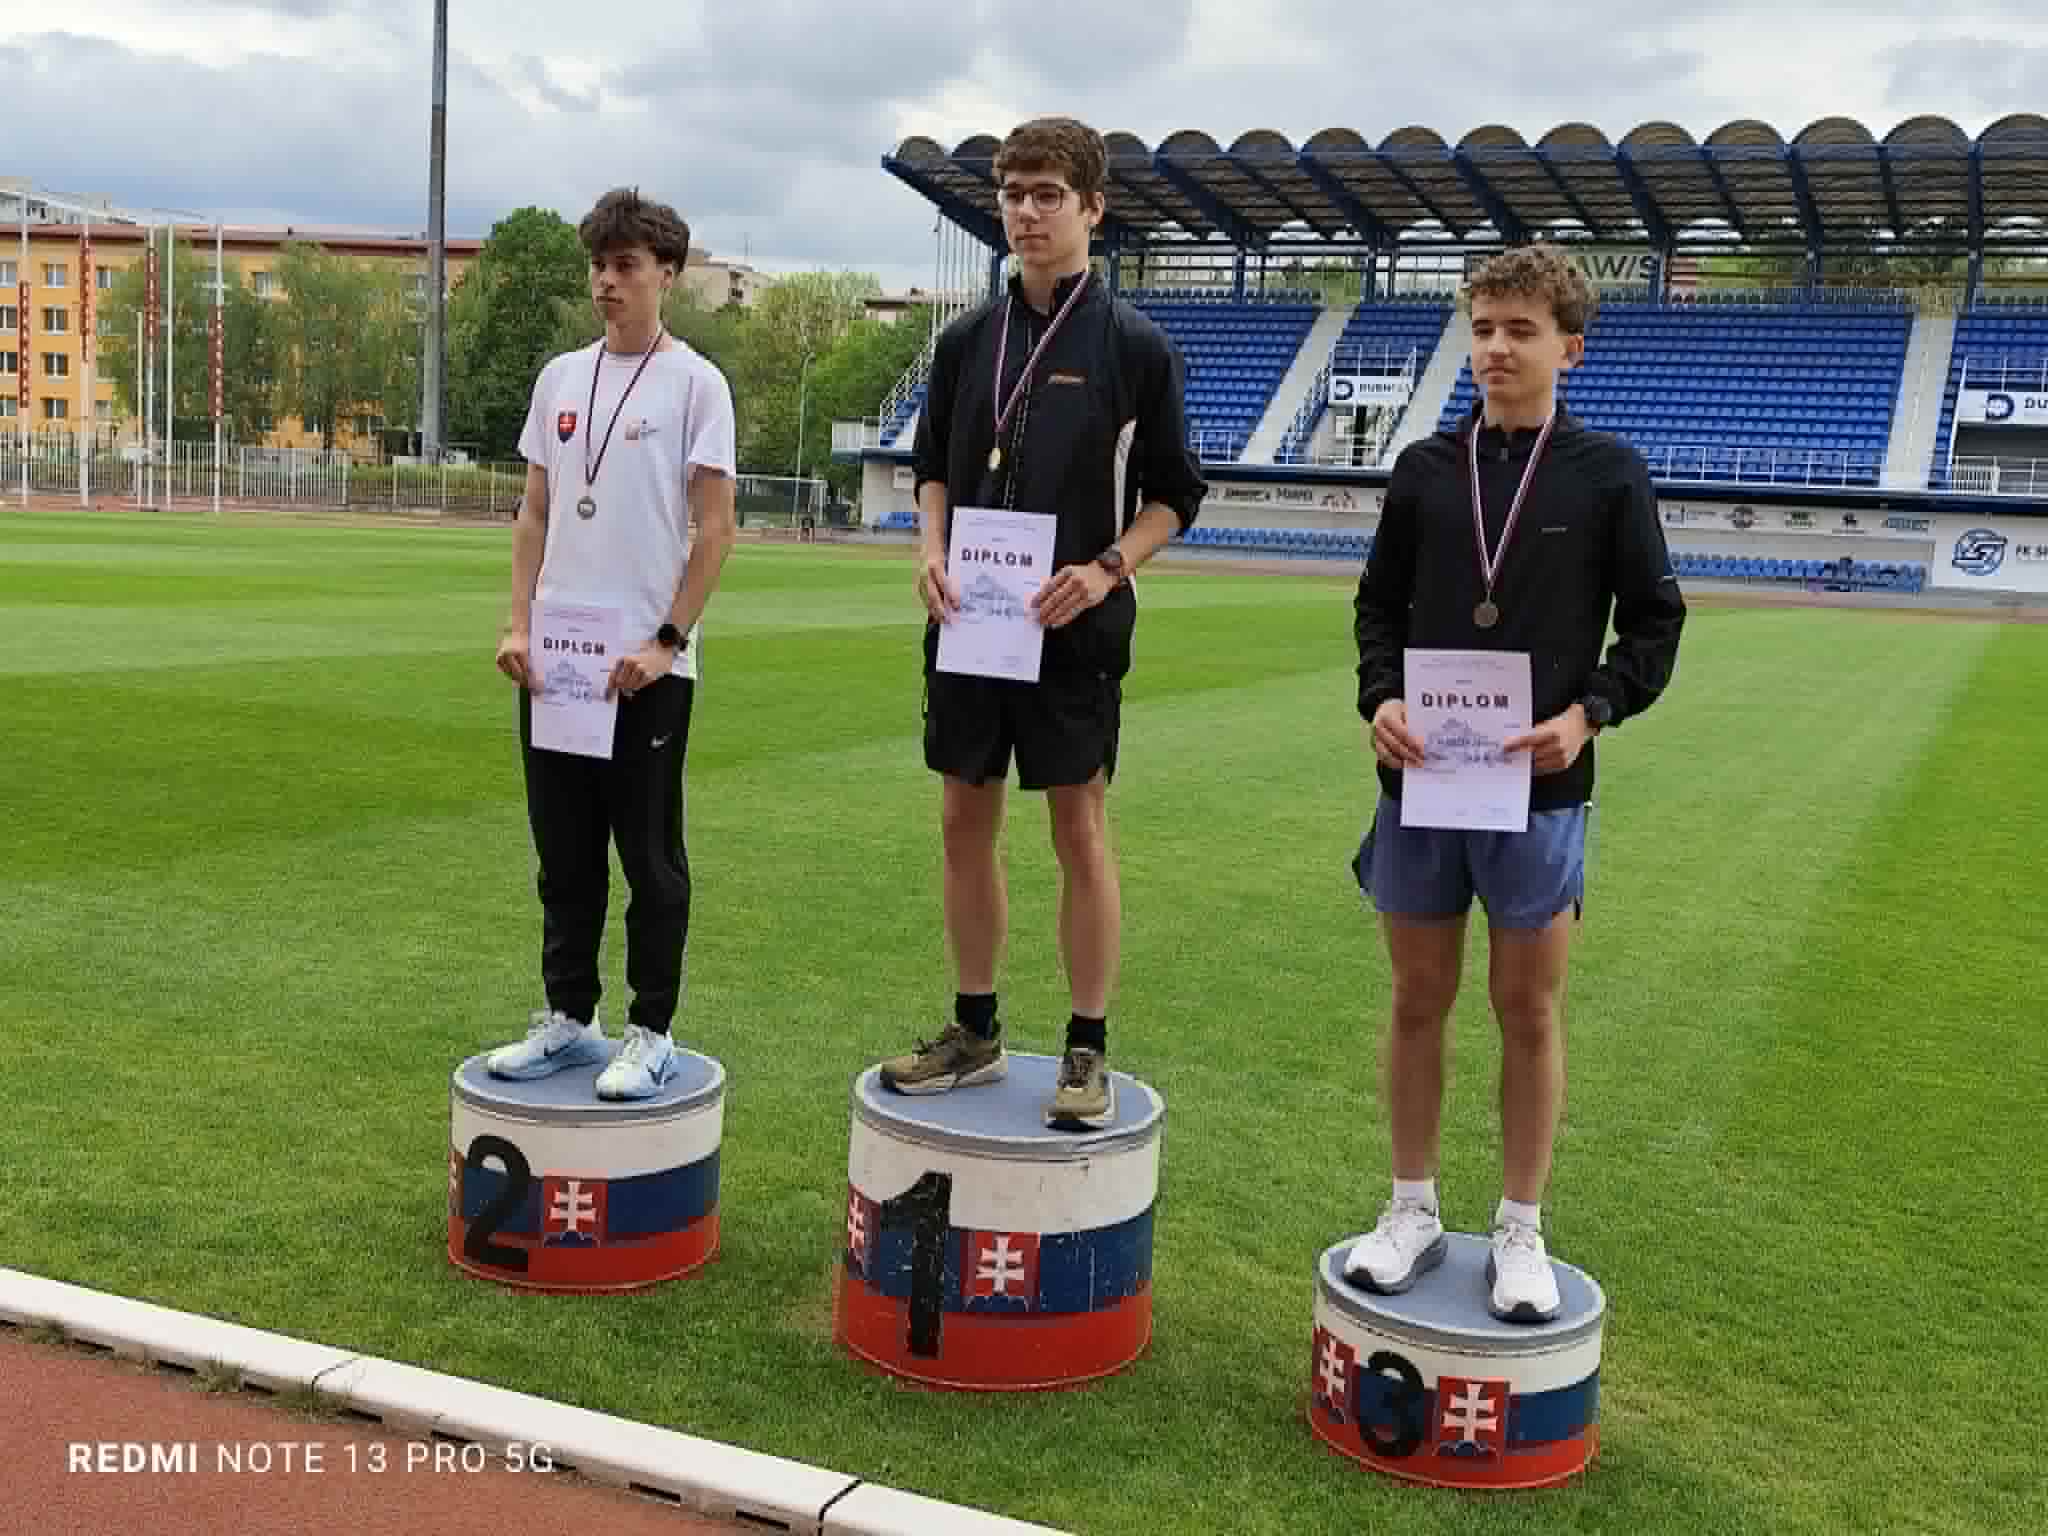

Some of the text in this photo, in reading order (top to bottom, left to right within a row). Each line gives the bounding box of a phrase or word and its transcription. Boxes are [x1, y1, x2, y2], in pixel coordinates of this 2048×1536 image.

[962, 548, 1033, 567] DIPLOM
[543, 637, 606, 656] DIPLOM
[1421, 693, 1509, 709] DIPLOM
[464, 1132, 531, 1272] 2
[880, 1169, 952, 1360] 1
[1357, 1350, 1425, 1457] 3
